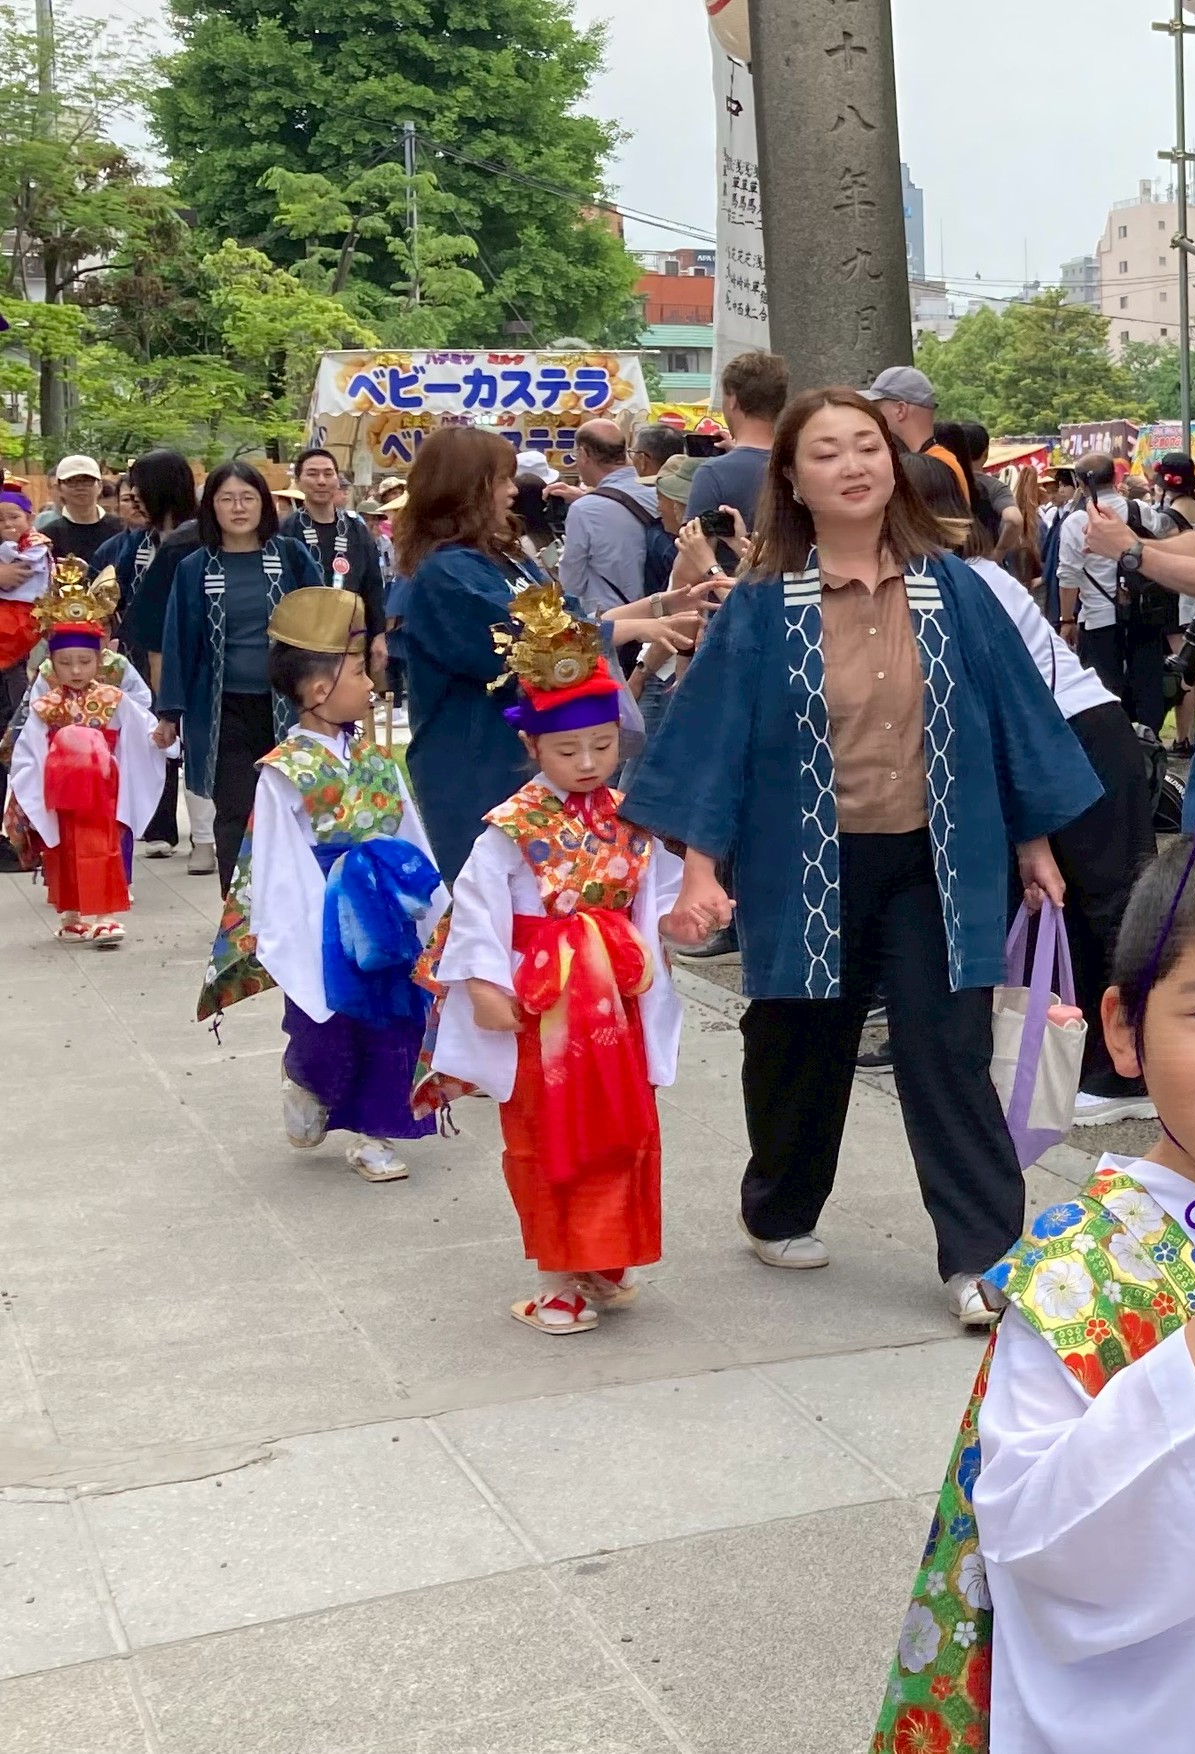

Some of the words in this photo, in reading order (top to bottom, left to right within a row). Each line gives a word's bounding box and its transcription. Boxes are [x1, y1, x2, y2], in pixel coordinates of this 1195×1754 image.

[824, 30, 884, 386] 十八年九月
[348, 365, 609, 409] ベビーカステラ
